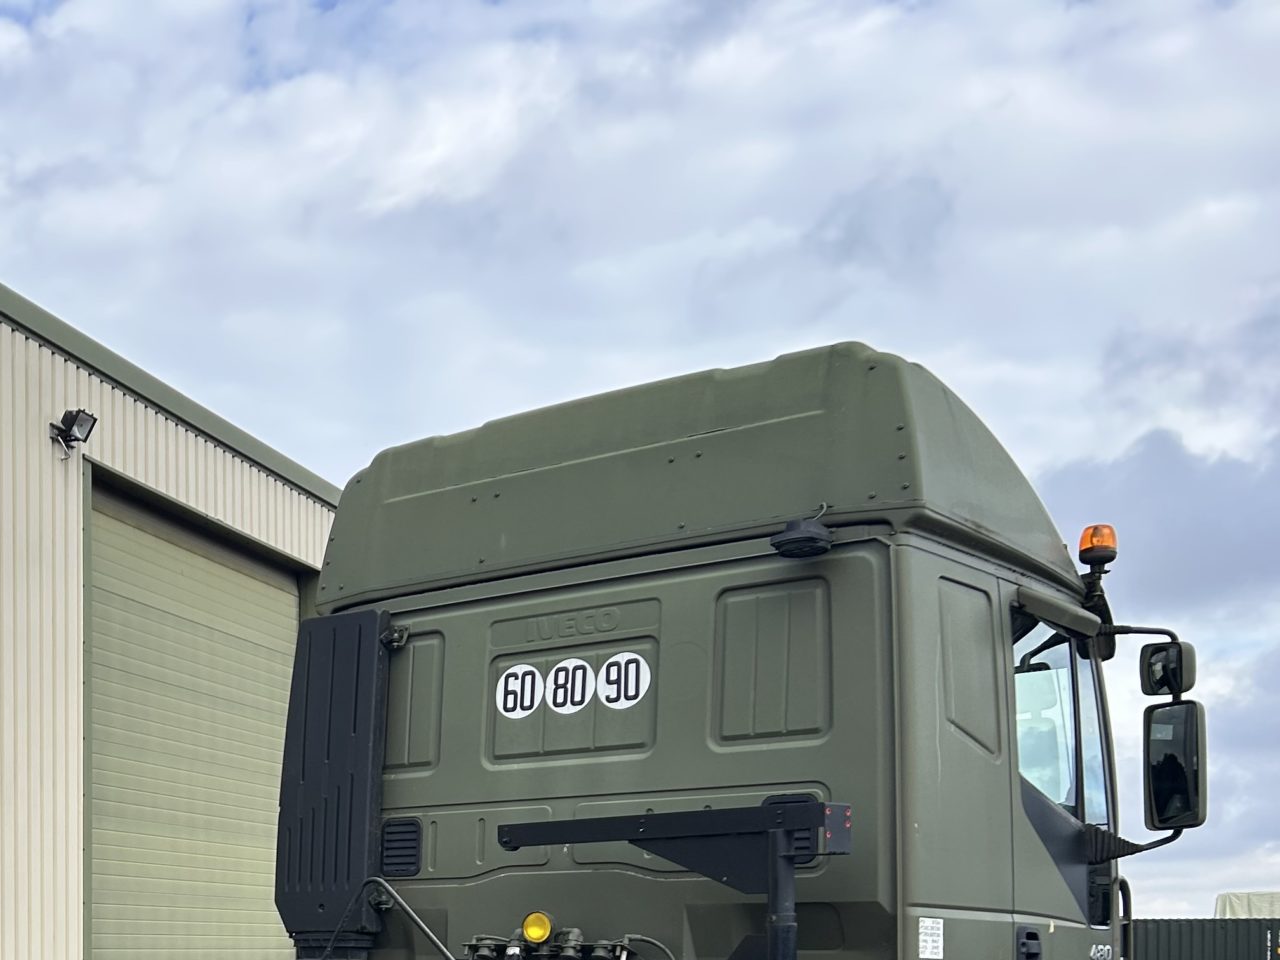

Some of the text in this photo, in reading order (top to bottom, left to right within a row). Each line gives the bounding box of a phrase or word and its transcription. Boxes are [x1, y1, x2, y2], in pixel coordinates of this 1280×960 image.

[526, 608, 618, 642] IVECO
[502, 657, 641, 713] 60 80 90
